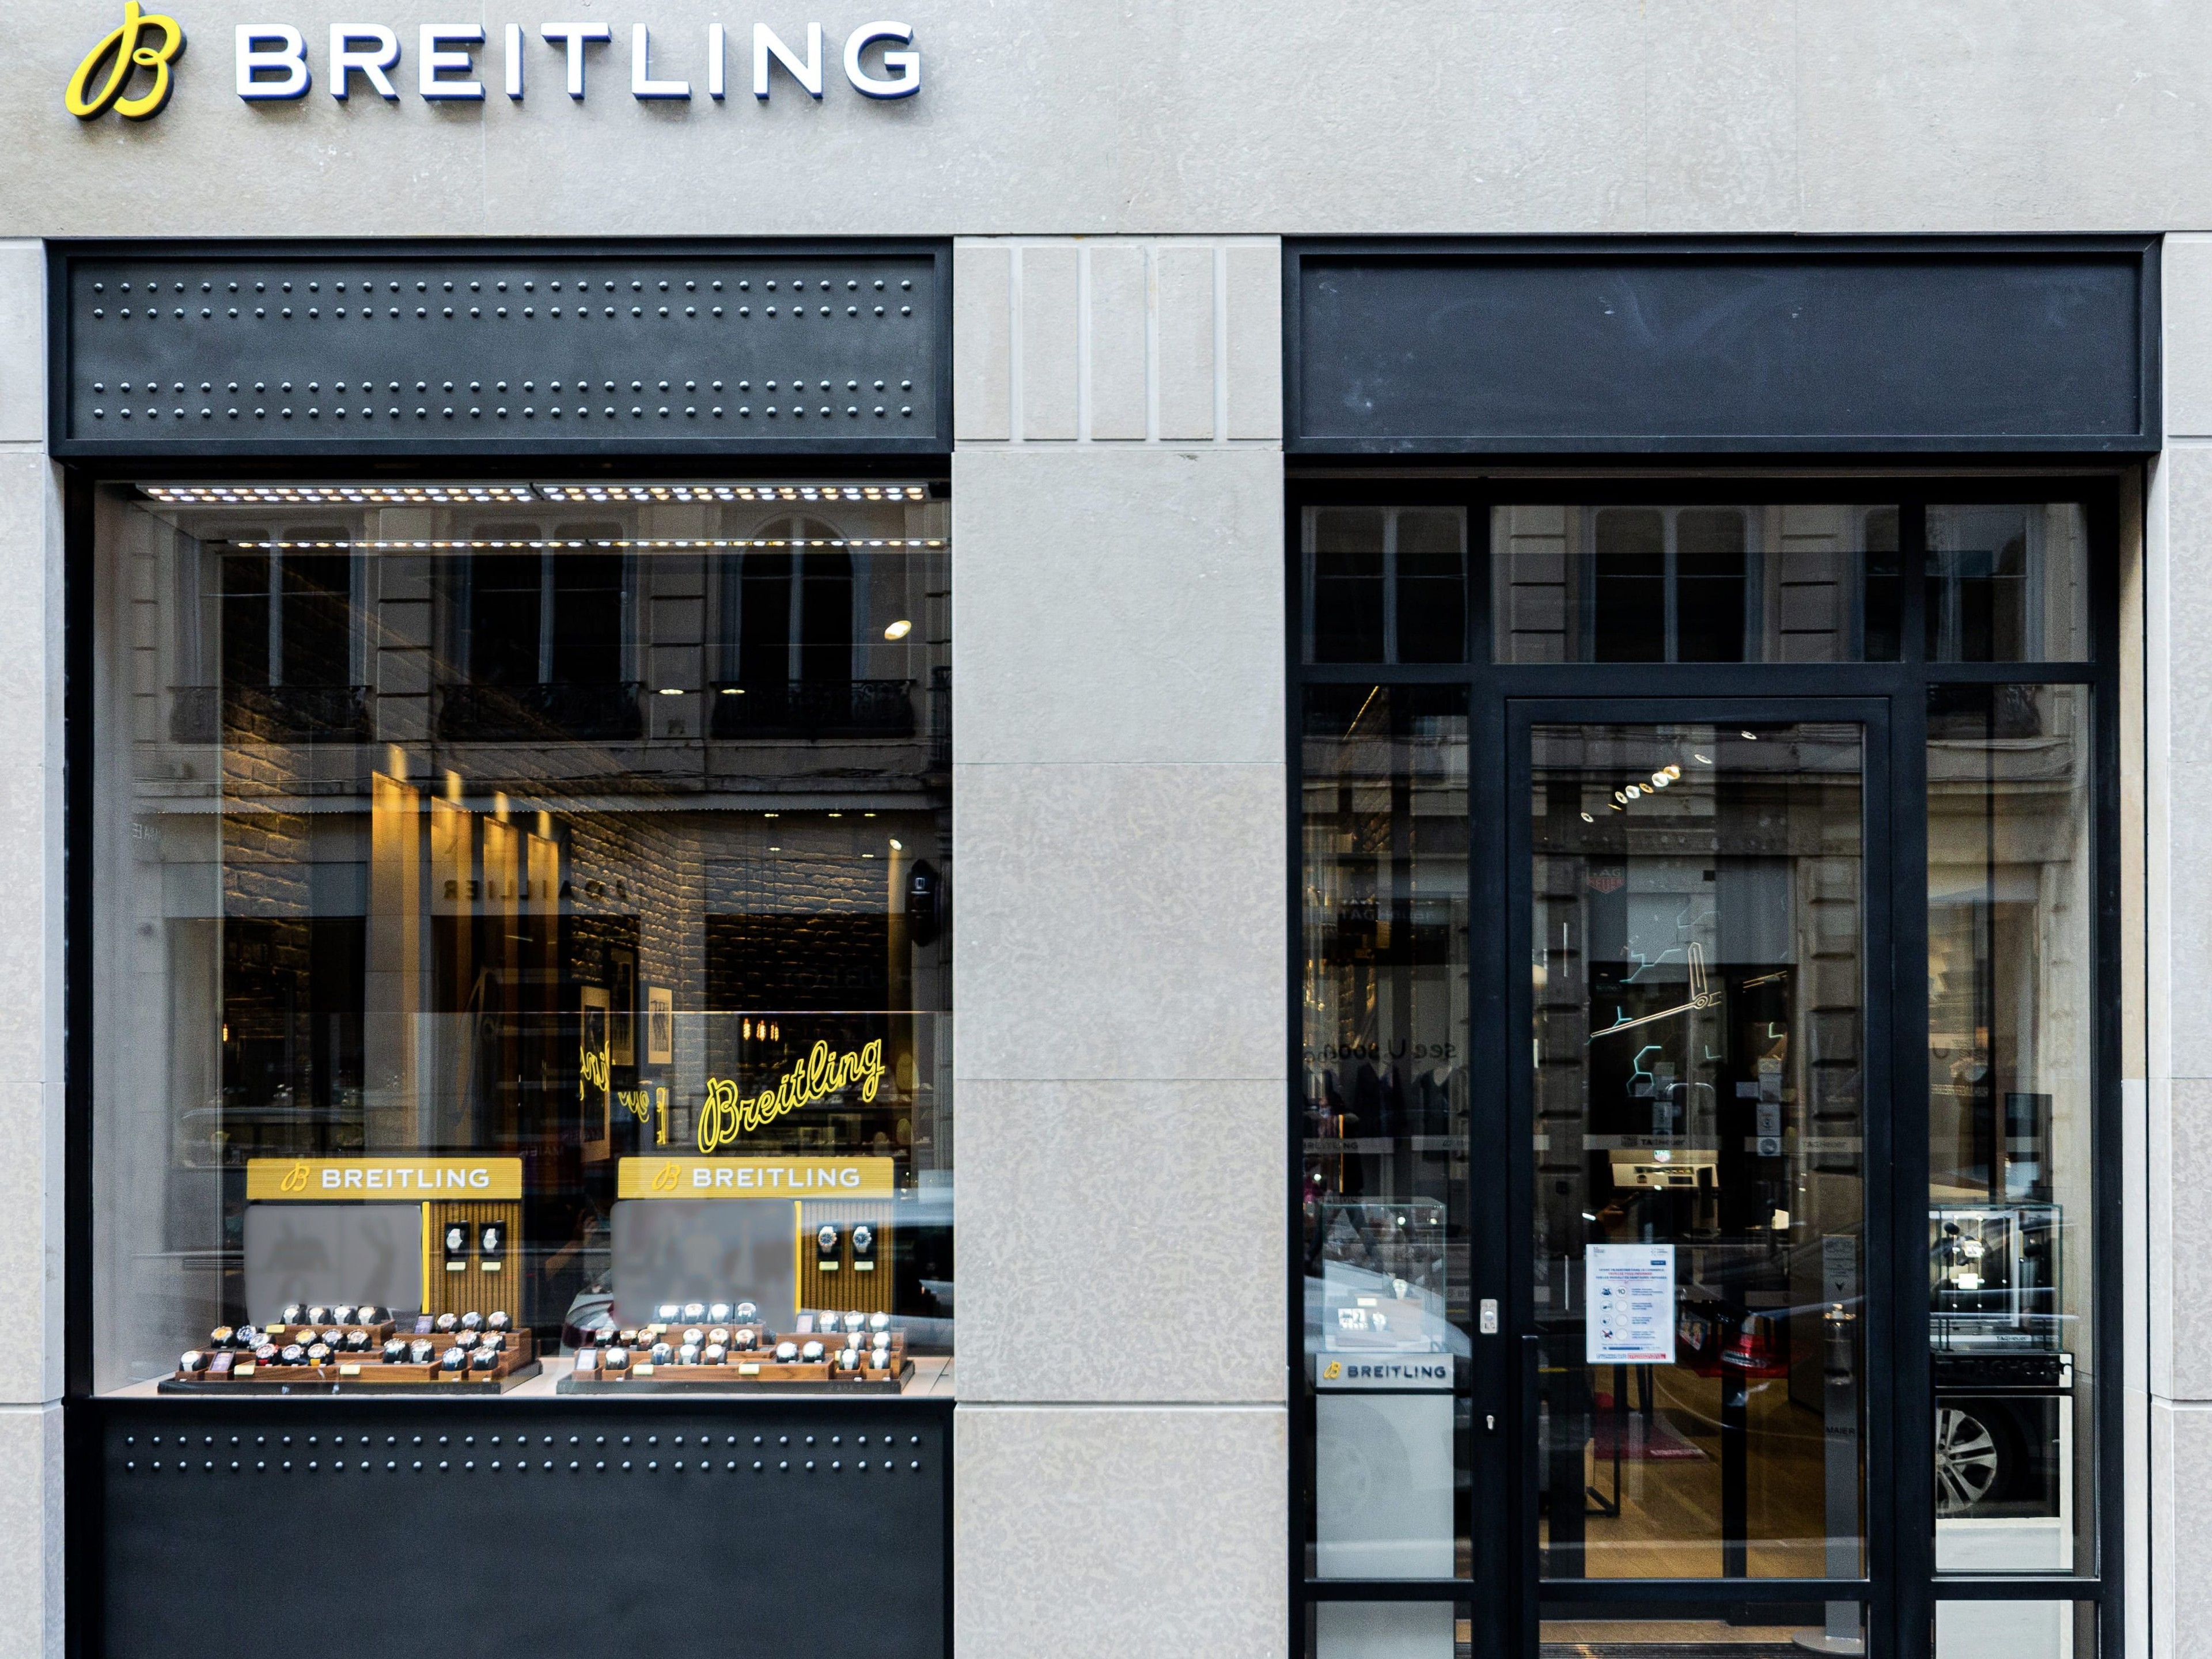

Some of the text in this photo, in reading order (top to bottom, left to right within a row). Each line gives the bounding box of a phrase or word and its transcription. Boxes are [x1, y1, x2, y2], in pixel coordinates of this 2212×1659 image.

[235, 21, 923, 102] BREITLING
[698, 1039, 885, 1153] Breitling
[321, 1168, 490, 1188] BREITLING
[692, 1168, 861, 1188] BREITLING
[1347, 1365, 1446, 1378] BREITLING
